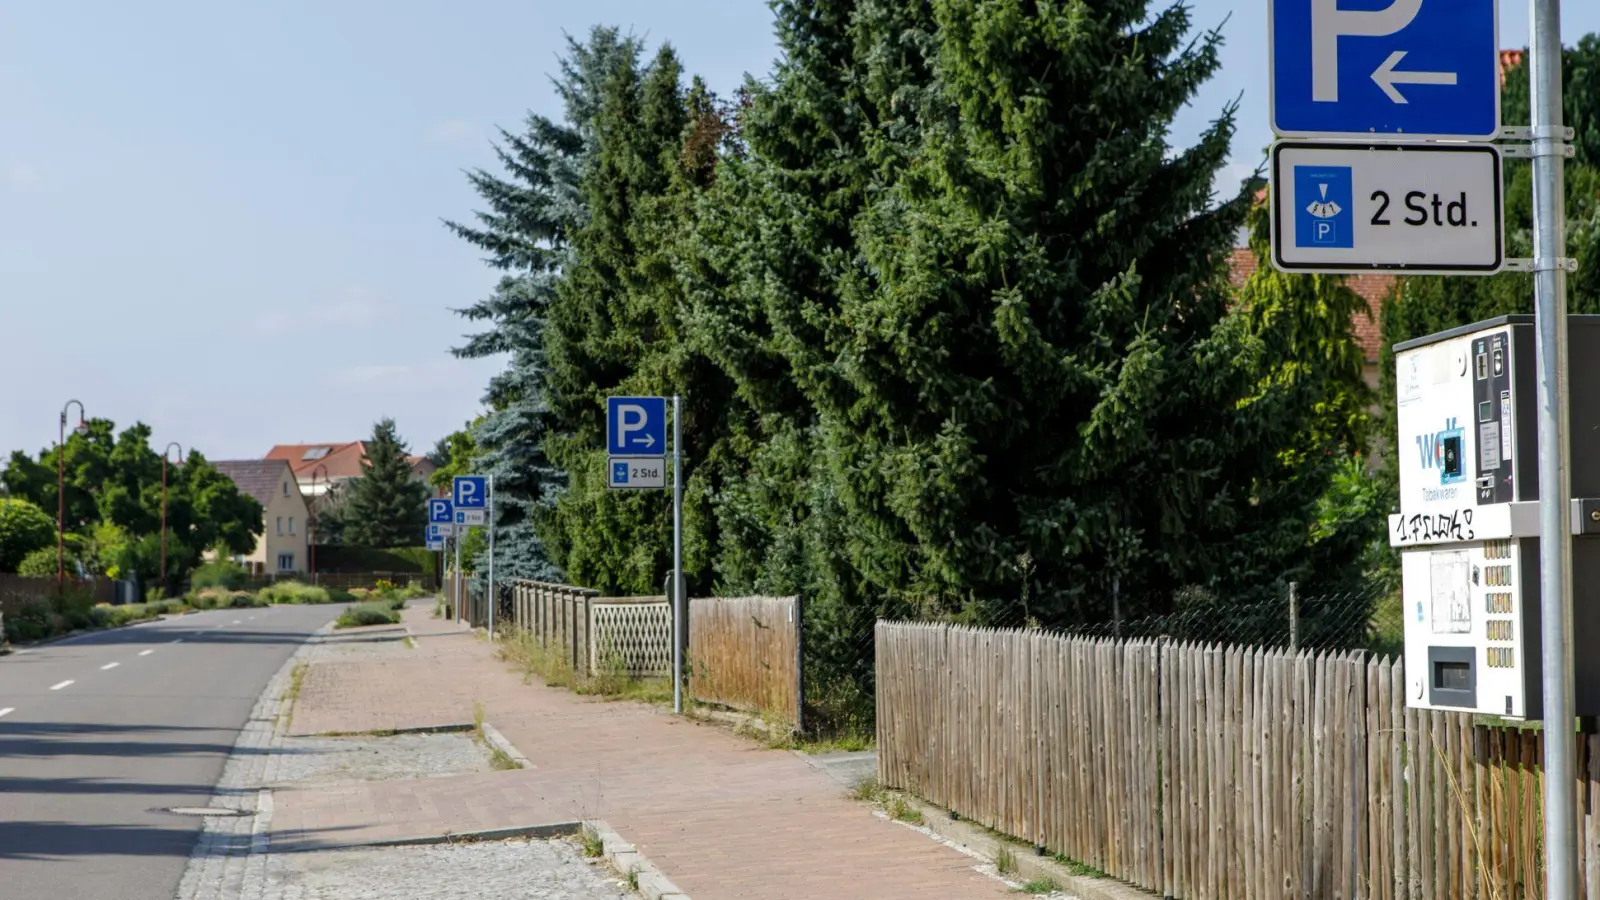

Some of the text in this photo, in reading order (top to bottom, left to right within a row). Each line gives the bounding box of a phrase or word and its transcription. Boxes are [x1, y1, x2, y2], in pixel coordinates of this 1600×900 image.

[1311, 0, 1424, 102] P
[1370, 190, 1478, 227] 2 Std.
[1318, 223, 1330, 240] P
[617, 404, 648, 448] P
[632, 468, 660, 478] 2 Std.
[459, 480, 476, 504] P
[1422, 486, 1459, 502] Tabakwaren
[432, 501, 446, 520] P
